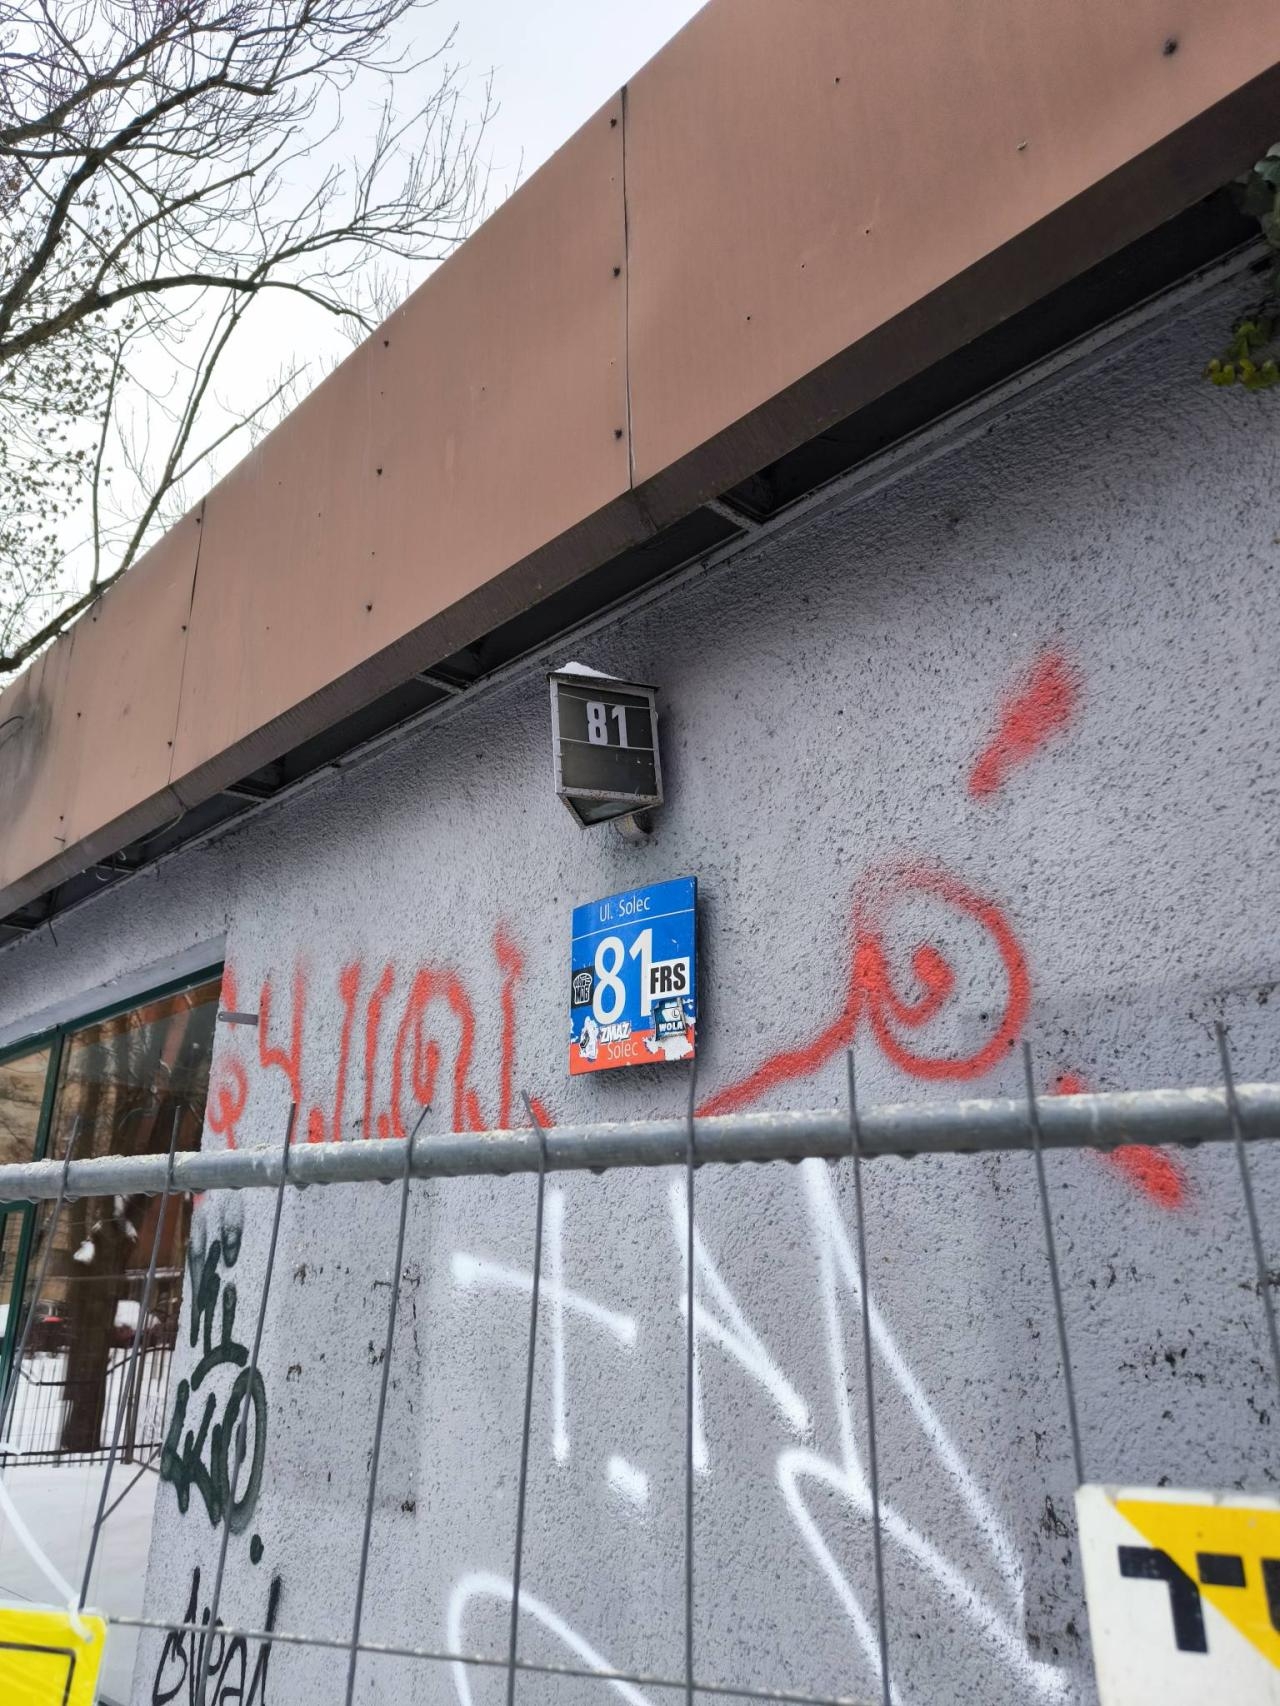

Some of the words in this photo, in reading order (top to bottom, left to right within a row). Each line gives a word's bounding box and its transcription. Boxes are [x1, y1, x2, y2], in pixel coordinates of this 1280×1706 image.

[586, 701, 628, 748] 81
[599, 903, 613, 922] Ul.
[619, 896, 651, 917] Solec
[592, 927, 652, 1025] 81
[650, 962, 687, 995] FRS
[658, 1020, 684, 1033] WOLA
[607, 1040, 639, 1060] Solec
[1117, 1545, 1280, 1655] T
